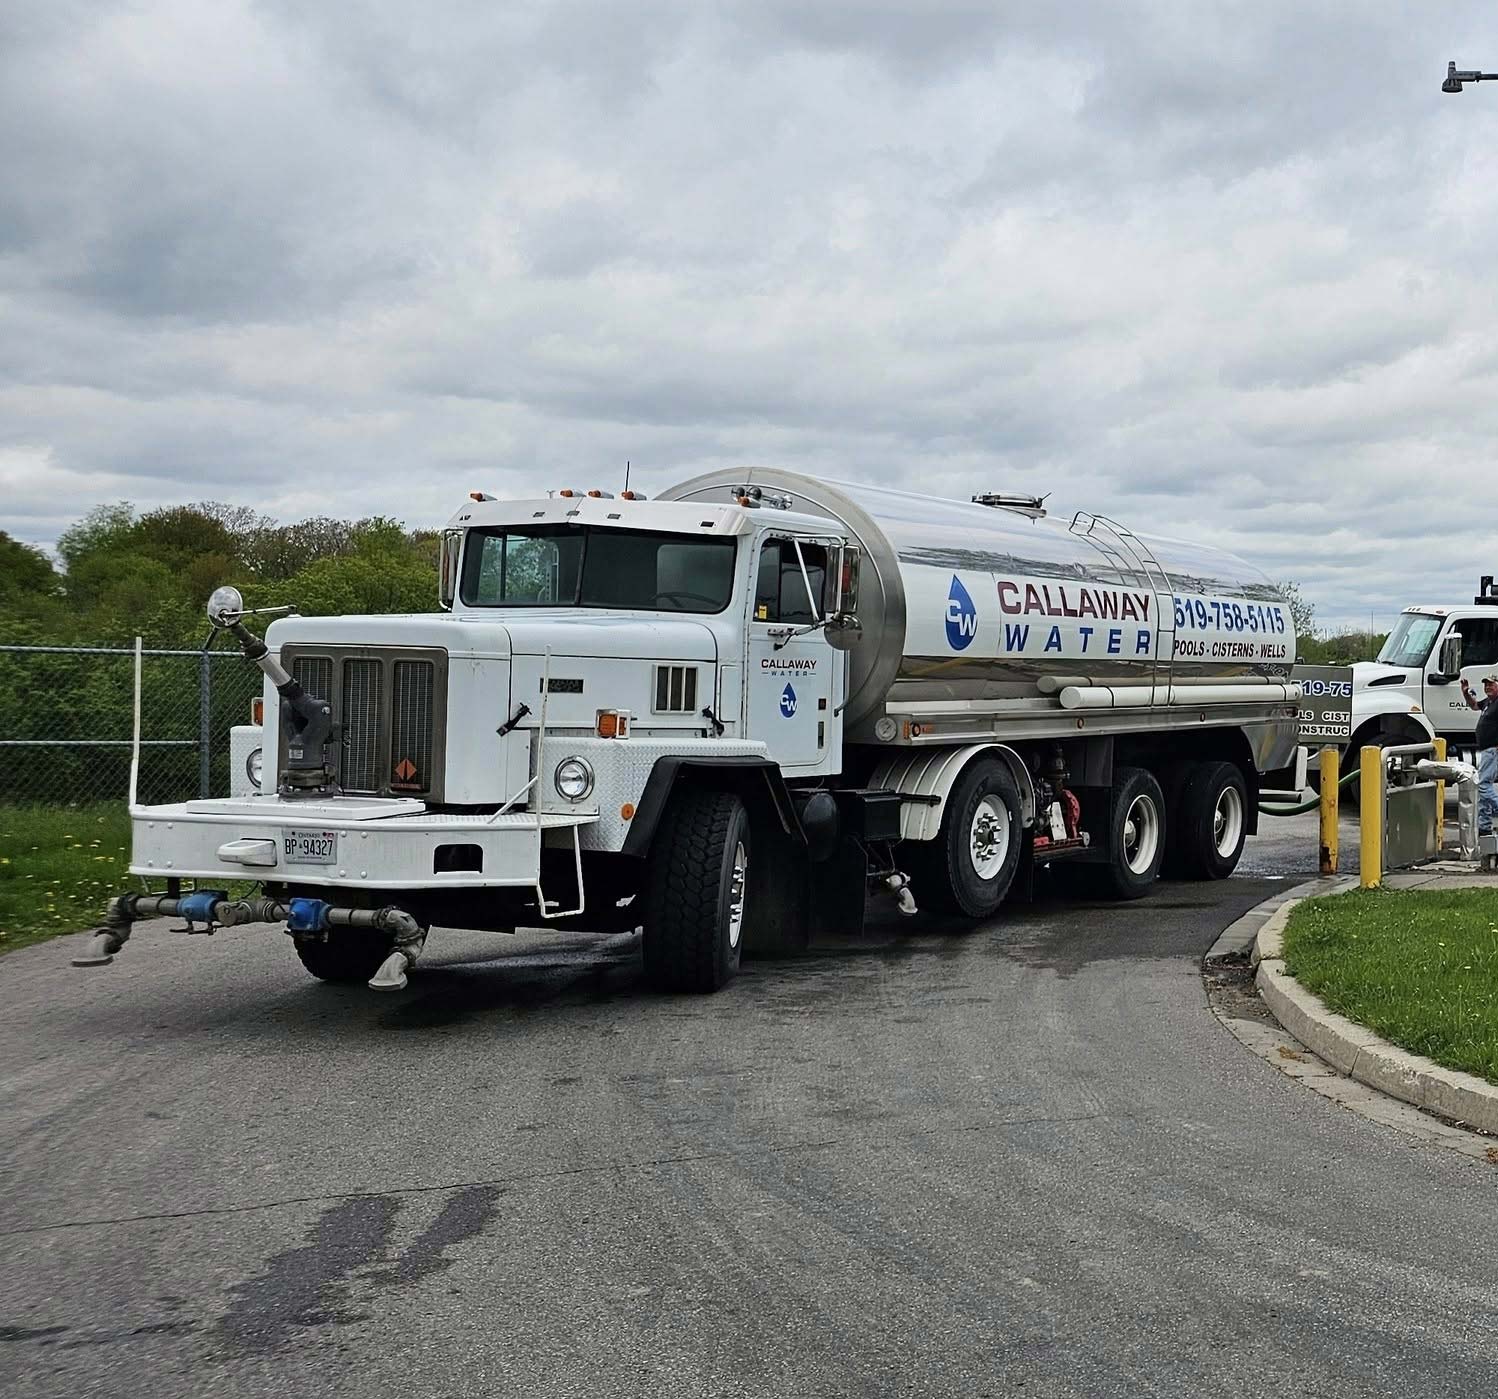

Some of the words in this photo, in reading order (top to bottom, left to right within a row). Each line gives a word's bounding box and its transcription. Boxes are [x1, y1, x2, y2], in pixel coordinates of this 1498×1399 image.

[997, 581, 1150, 622] CALLAWAY
[1174, 597, 1286, 635] 519-758-5115
[1005, 624, 1151, 655] WATER
[1174, 640, 1205, 657] POOLS
[1212, 640, 1255, 658] CISTERNS
[1260, 643, 1286, 659] WELLS
[761, 659, 817, 670] CALLAWAY
[1290, 680, 1352, 698] 19-75
[1298, 724, 1350, 737] NSTRUC
[285, 838, 297, 855] BP
[303, 839, 333, 857] 94327
